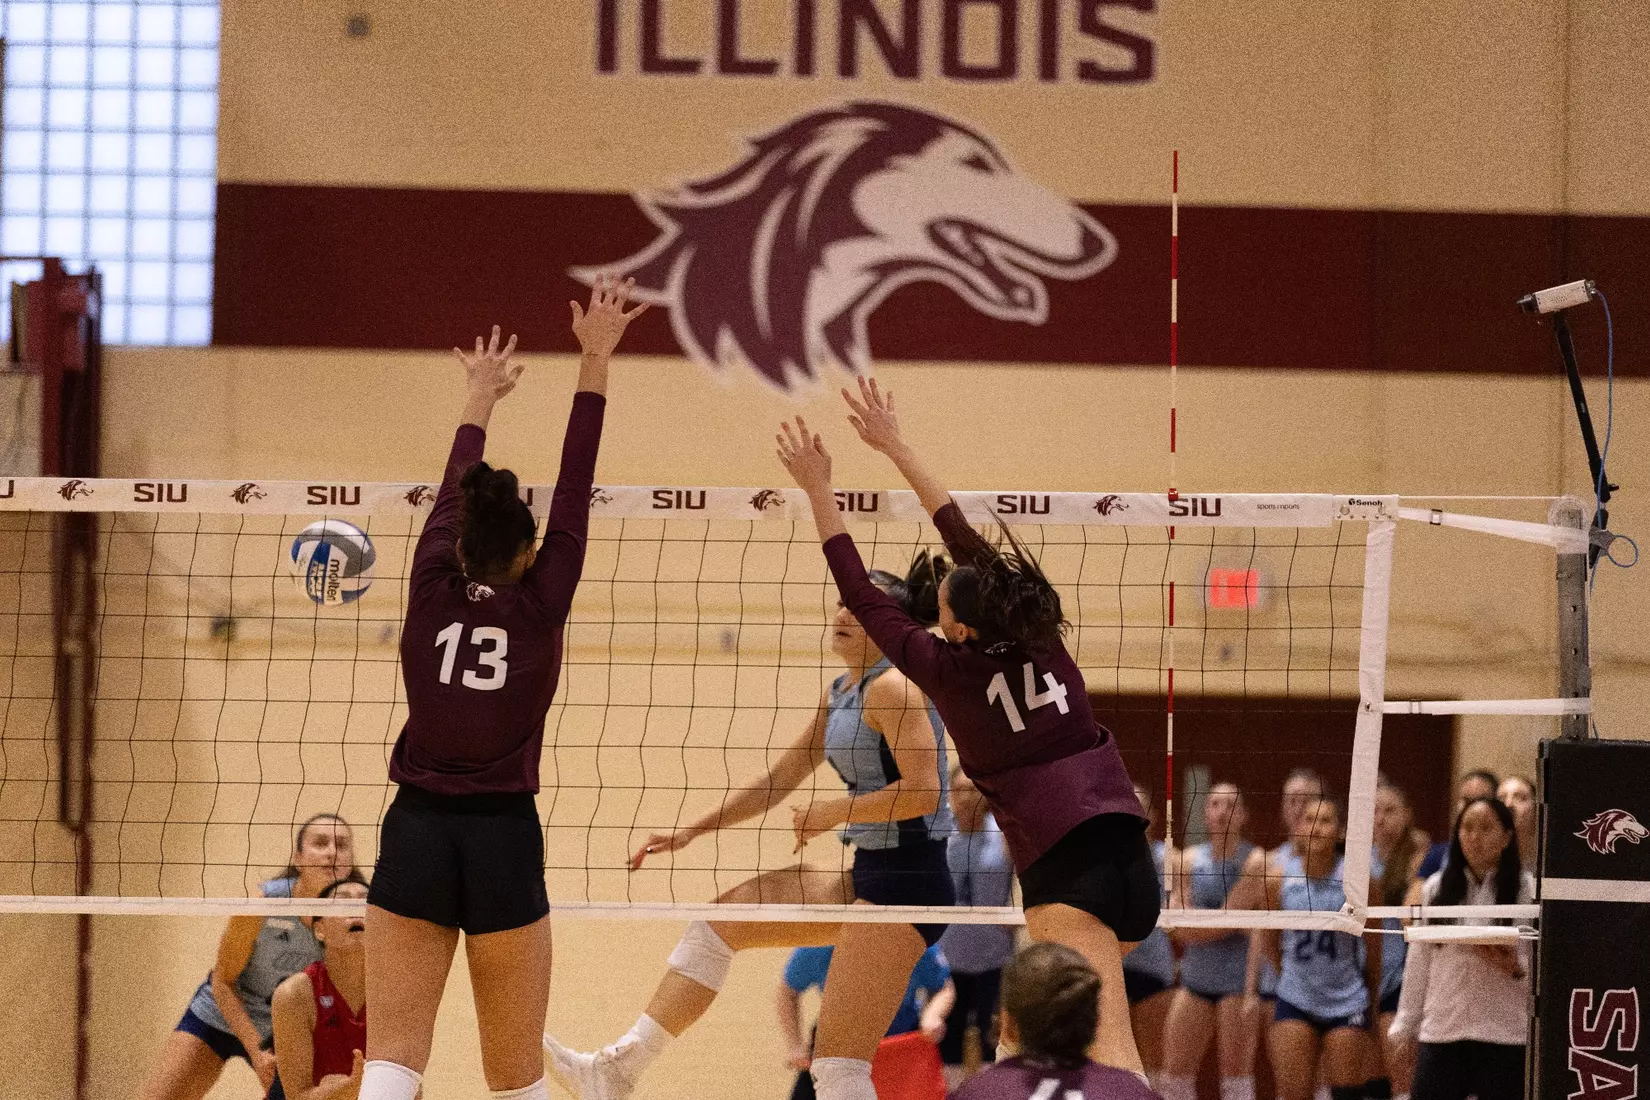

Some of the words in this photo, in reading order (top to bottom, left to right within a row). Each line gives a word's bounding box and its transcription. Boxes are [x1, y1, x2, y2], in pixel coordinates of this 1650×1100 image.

[597, 0, 1157, 84] ILLINOIS
[134, 483, 188, 503] SIU
[306, 485, 361, 506] SIU
[652, 489, 706, 510] SIU
[1356, 499, 1383, 507] Senoh
[997, 494, 1050, 515] SIU
[1168, 497, 1222, 517] SIU
[326, 559, 341, 601] molten
[435, 621, 508, 691] 13
[986, 661, 1070, 733] 14
[1293, 929, 1337, 962] 24
